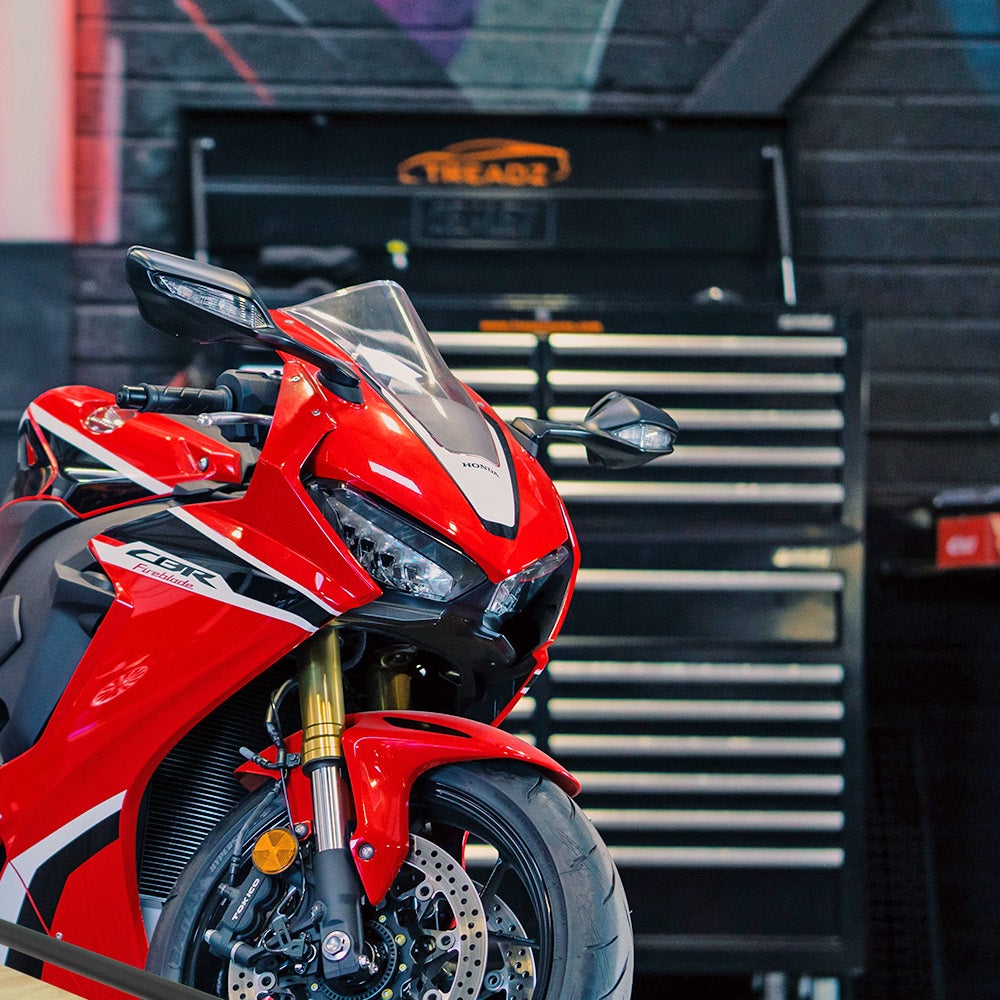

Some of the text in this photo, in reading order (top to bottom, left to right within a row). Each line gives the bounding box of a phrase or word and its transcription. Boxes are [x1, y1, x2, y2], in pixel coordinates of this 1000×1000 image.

[461, 462, 500, 479] HONDA
[125, 549, 218, 591] CBR
[132, 562, 195, 591] Fireblade
[231, 878, 260, 921] TOKICO
